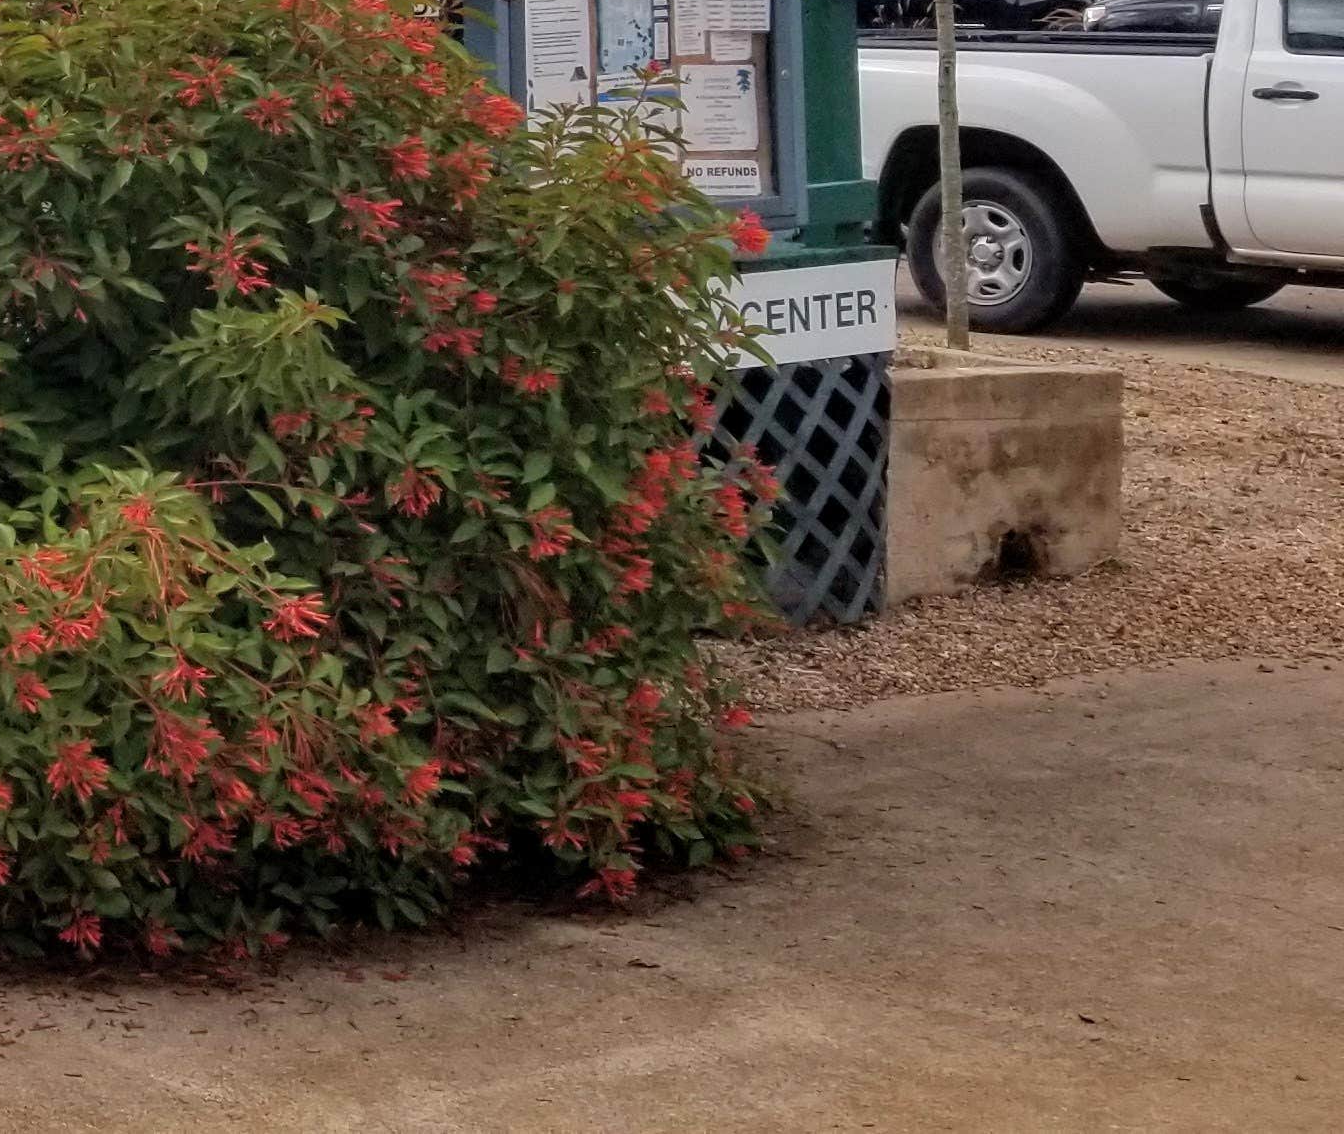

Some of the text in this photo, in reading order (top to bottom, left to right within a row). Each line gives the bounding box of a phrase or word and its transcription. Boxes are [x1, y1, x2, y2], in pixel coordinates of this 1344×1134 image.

[687, 167, 758, 177] NO REFUNDS
[740, 289, 877, 335] CENTER
